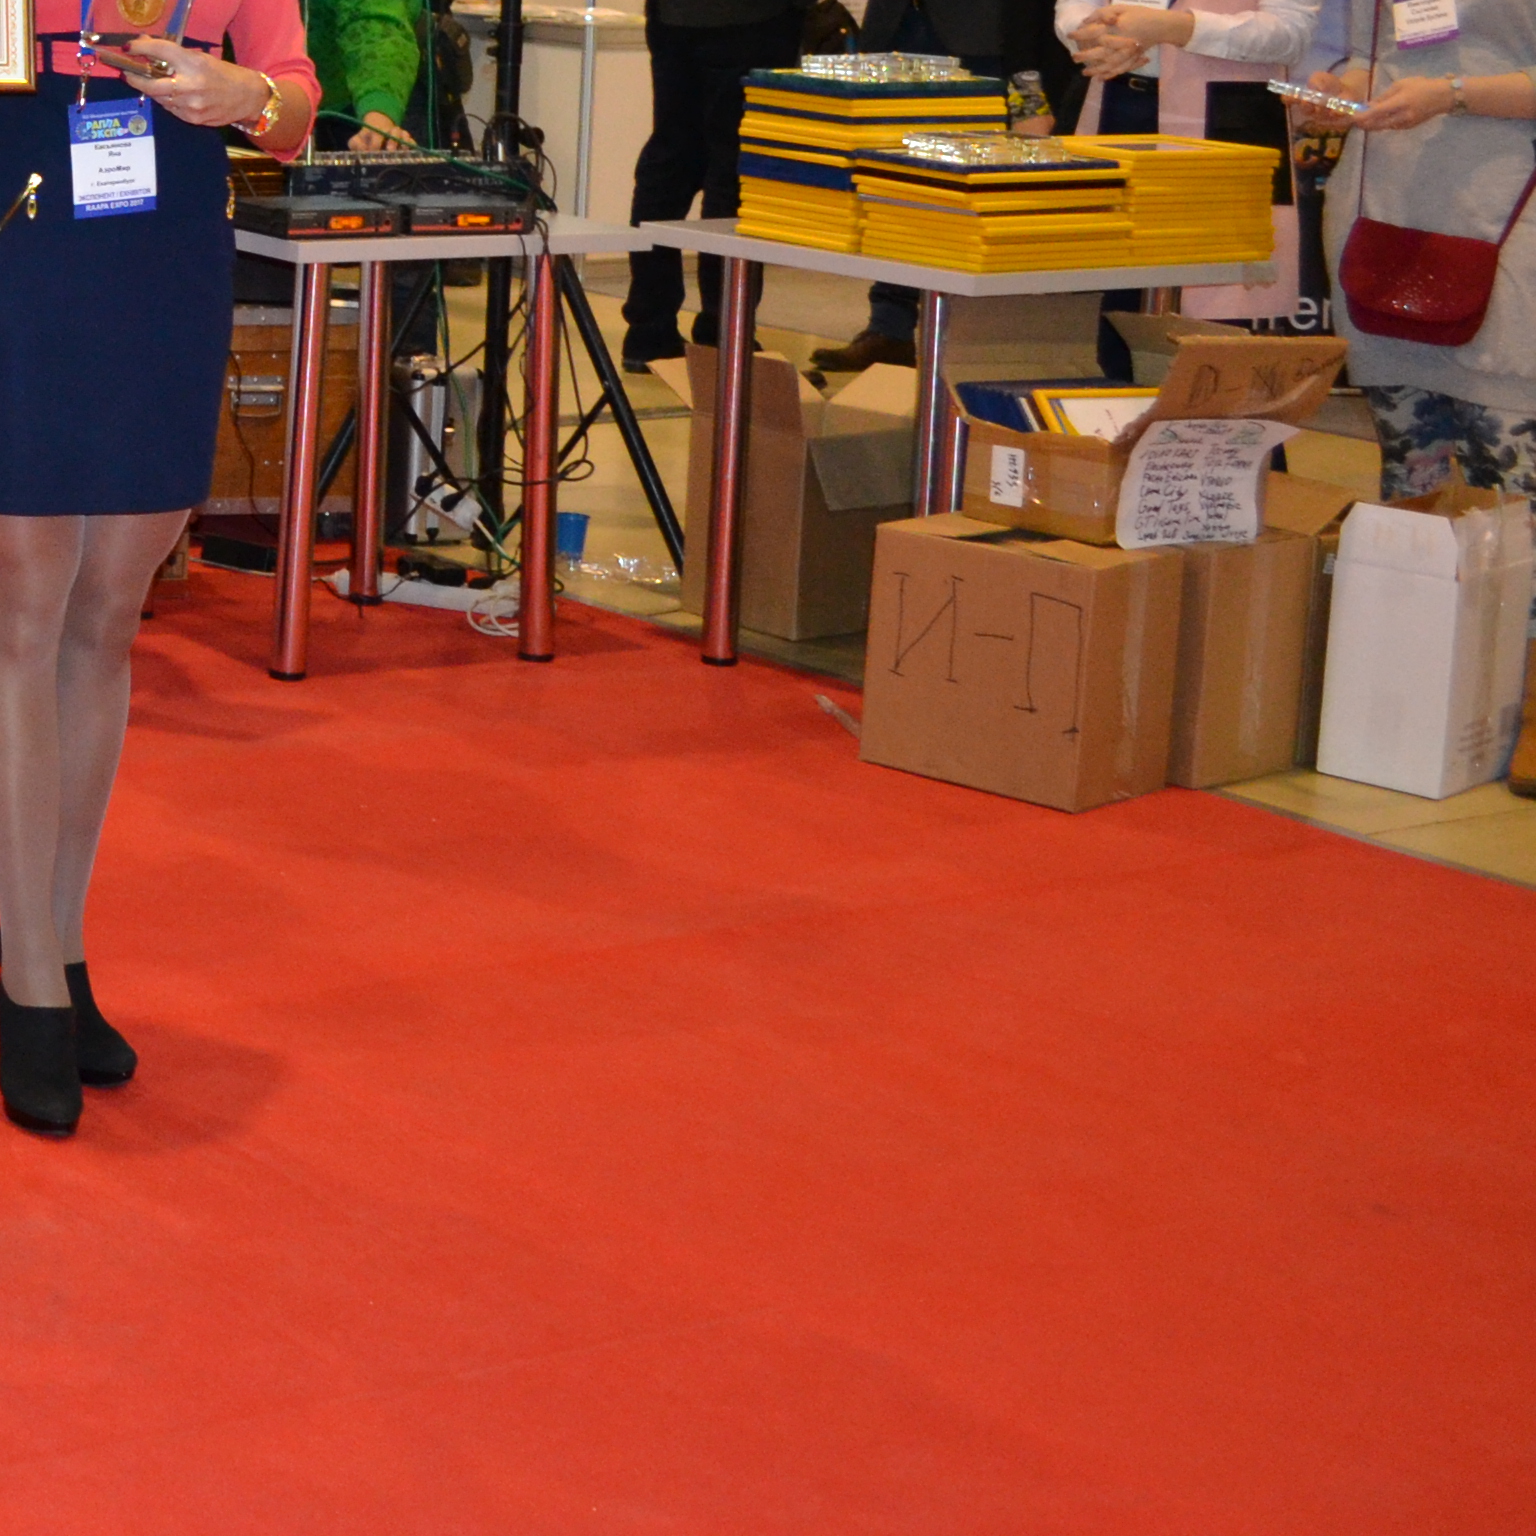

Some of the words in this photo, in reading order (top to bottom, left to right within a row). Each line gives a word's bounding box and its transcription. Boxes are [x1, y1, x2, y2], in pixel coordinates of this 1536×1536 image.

[86, 117, 121, 131] РАППА
[85, 203, 109, 212] RAAPA
[110, 201, 129, 209] EXPO
